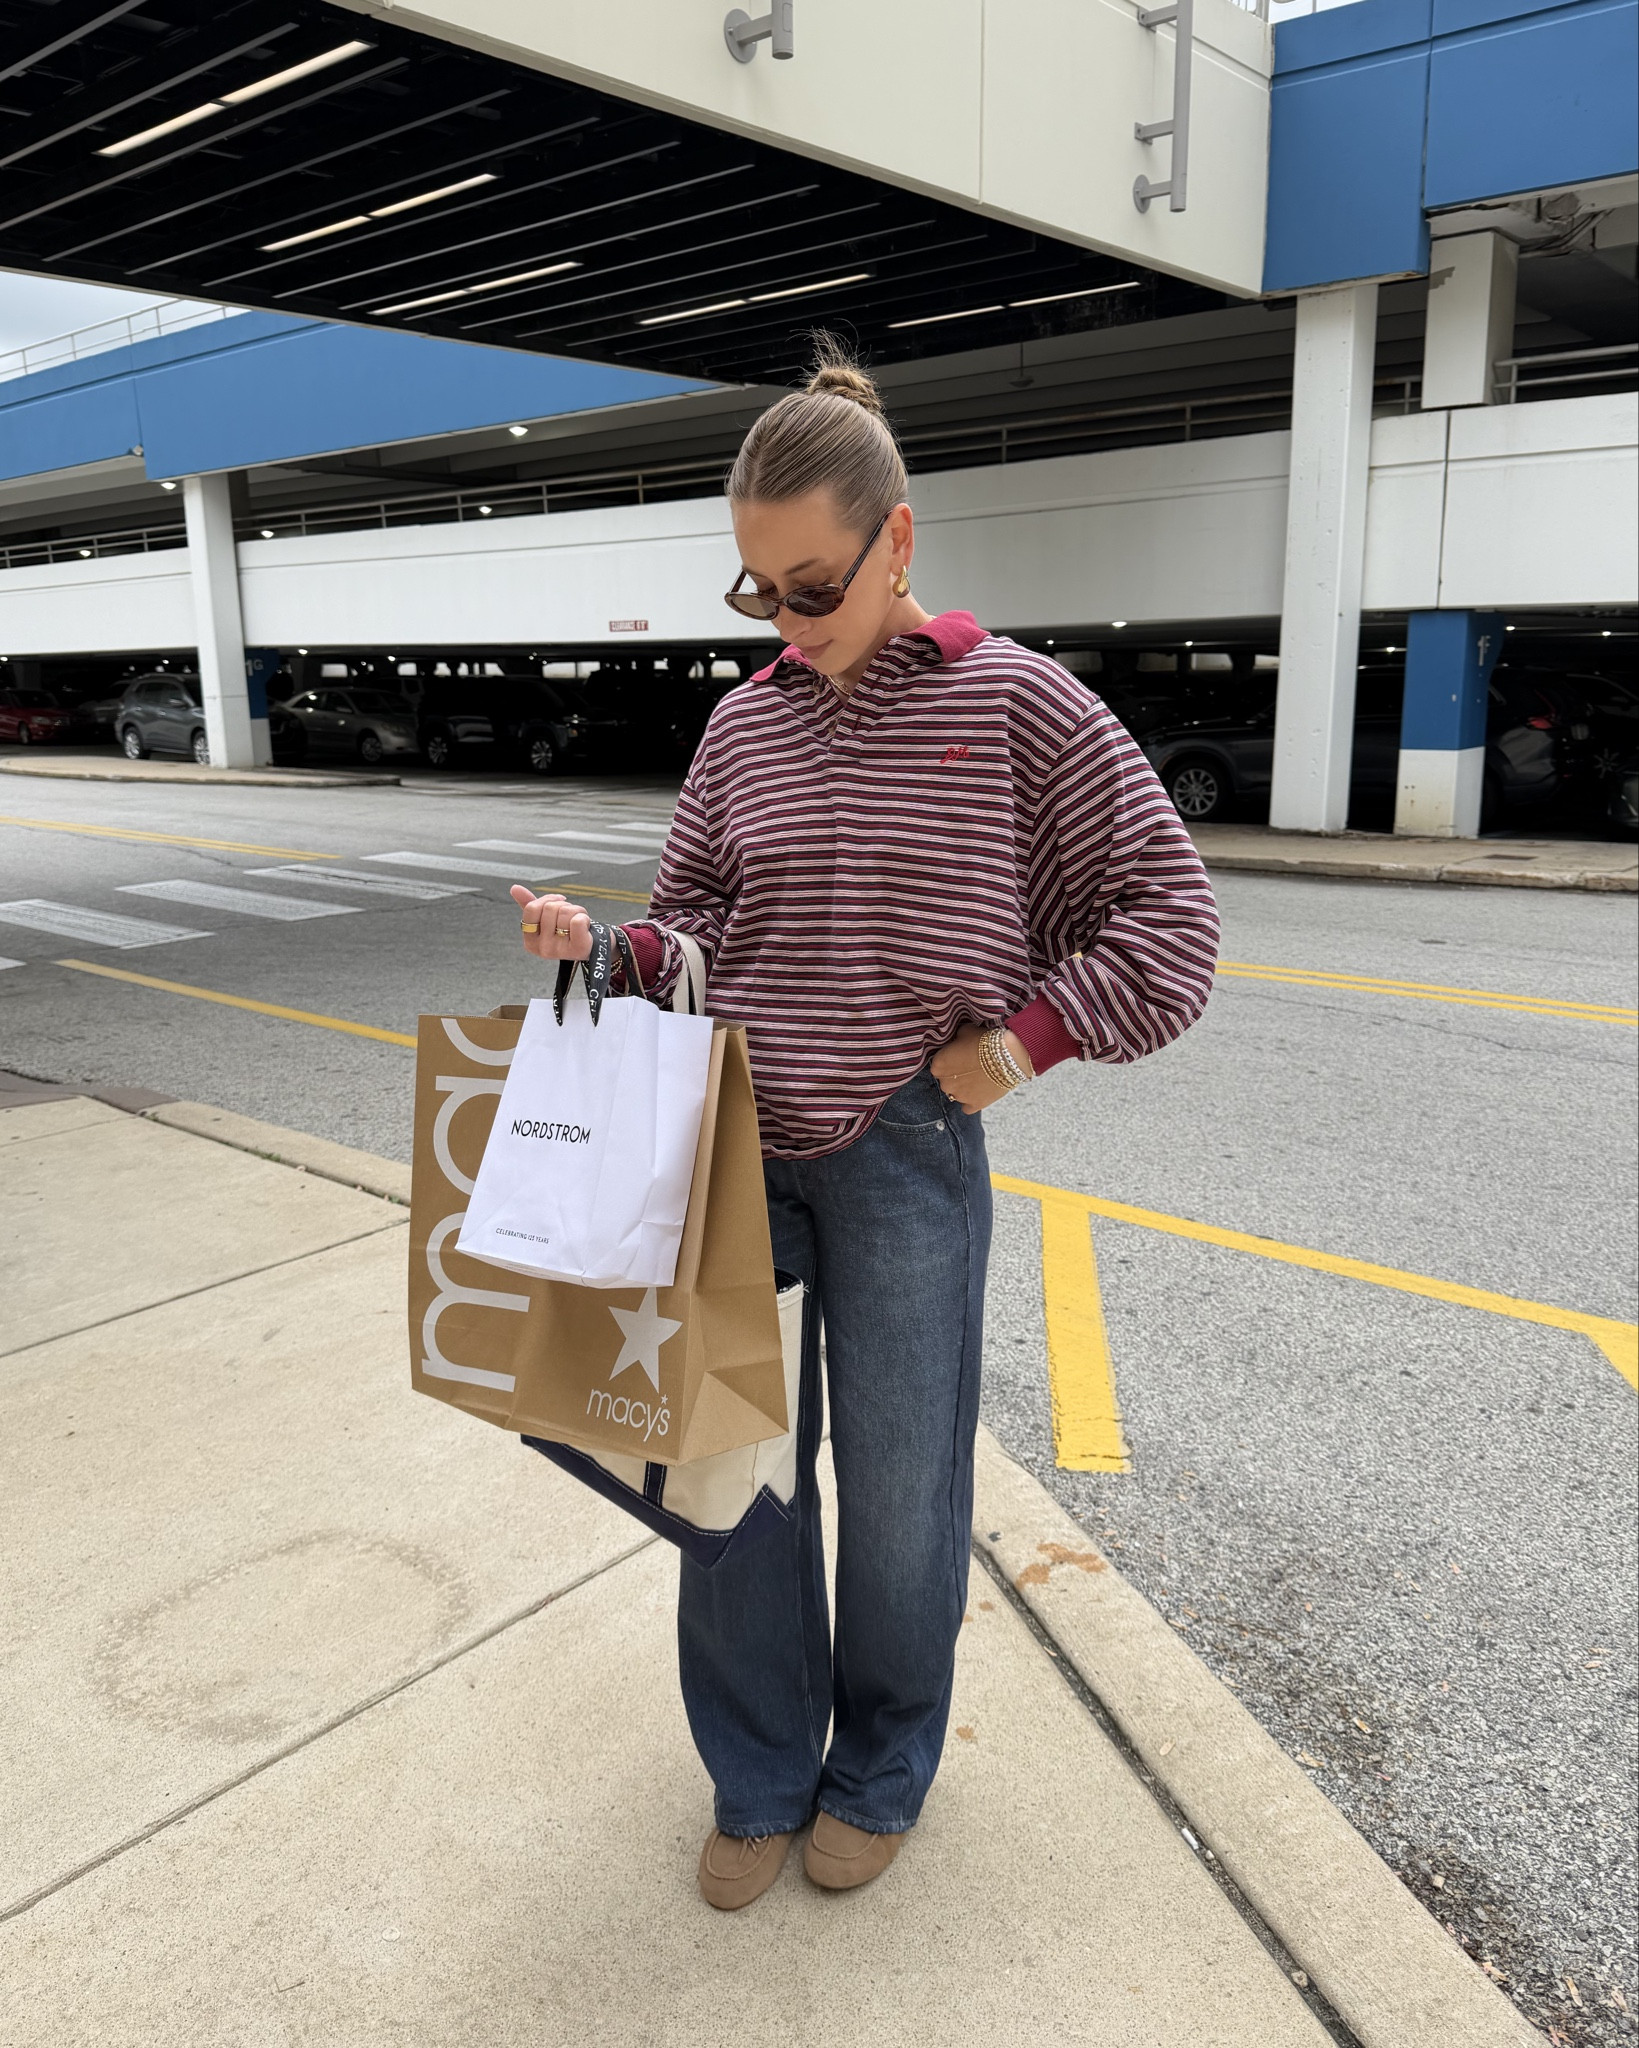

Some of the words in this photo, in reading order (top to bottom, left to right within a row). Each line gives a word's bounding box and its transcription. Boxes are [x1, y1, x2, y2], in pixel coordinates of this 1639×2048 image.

[593, 938, 608, 980] YEARS
[510, 1119, 592, 1144] NORDSTROM
[495, 1227, 528, 1240] CELEBRATING
[535, 1236, 550, 1244] YEARS
